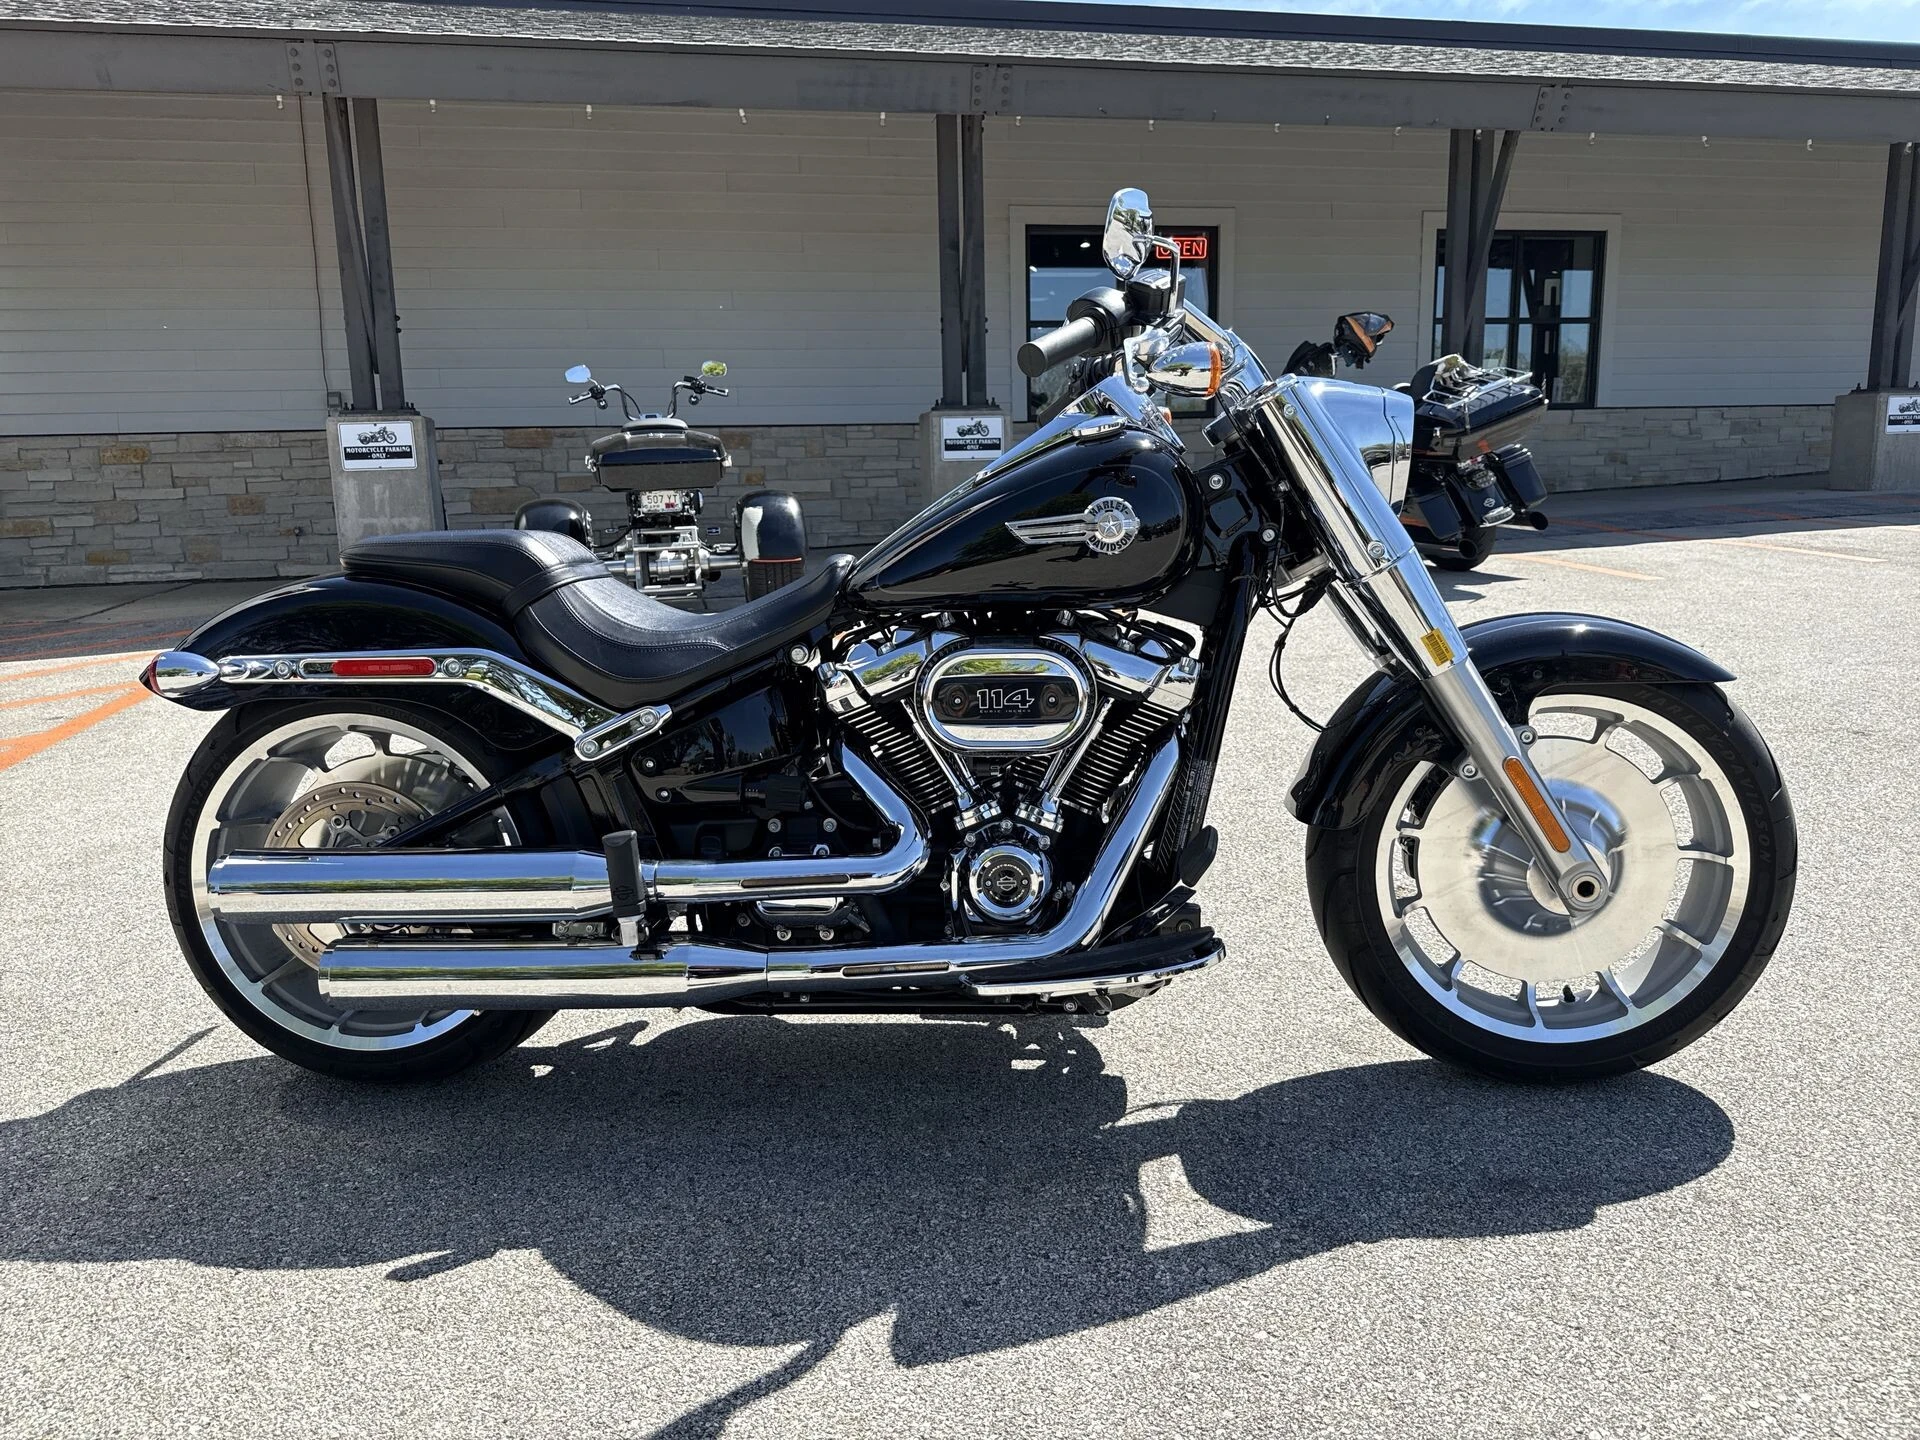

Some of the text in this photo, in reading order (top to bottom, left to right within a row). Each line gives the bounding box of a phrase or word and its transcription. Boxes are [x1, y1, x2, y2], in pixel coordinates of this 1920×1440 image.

[646, 494, 678, 505] 507 YT
[1088, 532, 1133, 552] DAVIDSON
[976, 688, 1035, 709] 114
